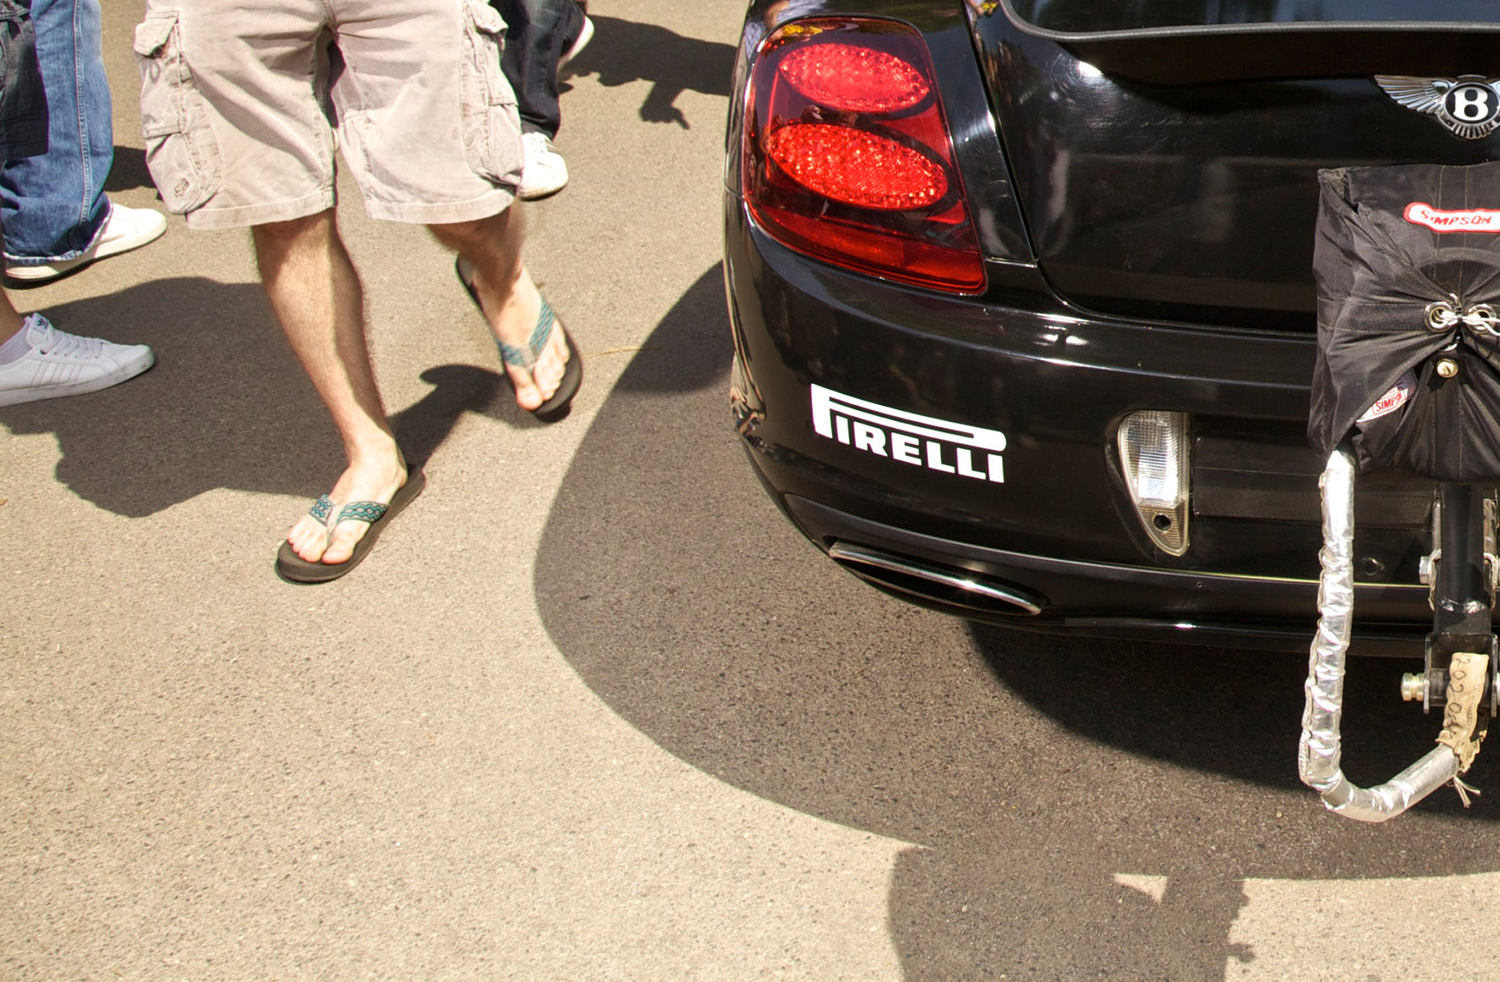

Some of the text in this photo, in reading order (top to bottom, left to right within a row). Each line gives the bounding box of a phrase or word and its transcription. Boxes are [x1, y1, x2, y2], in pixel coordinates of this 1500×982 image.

[1453, 86, 1488, 121] B
[1420, 210, 1493, 226] SIMPSON
[810, 383, 1007, 484] PIRELLI
